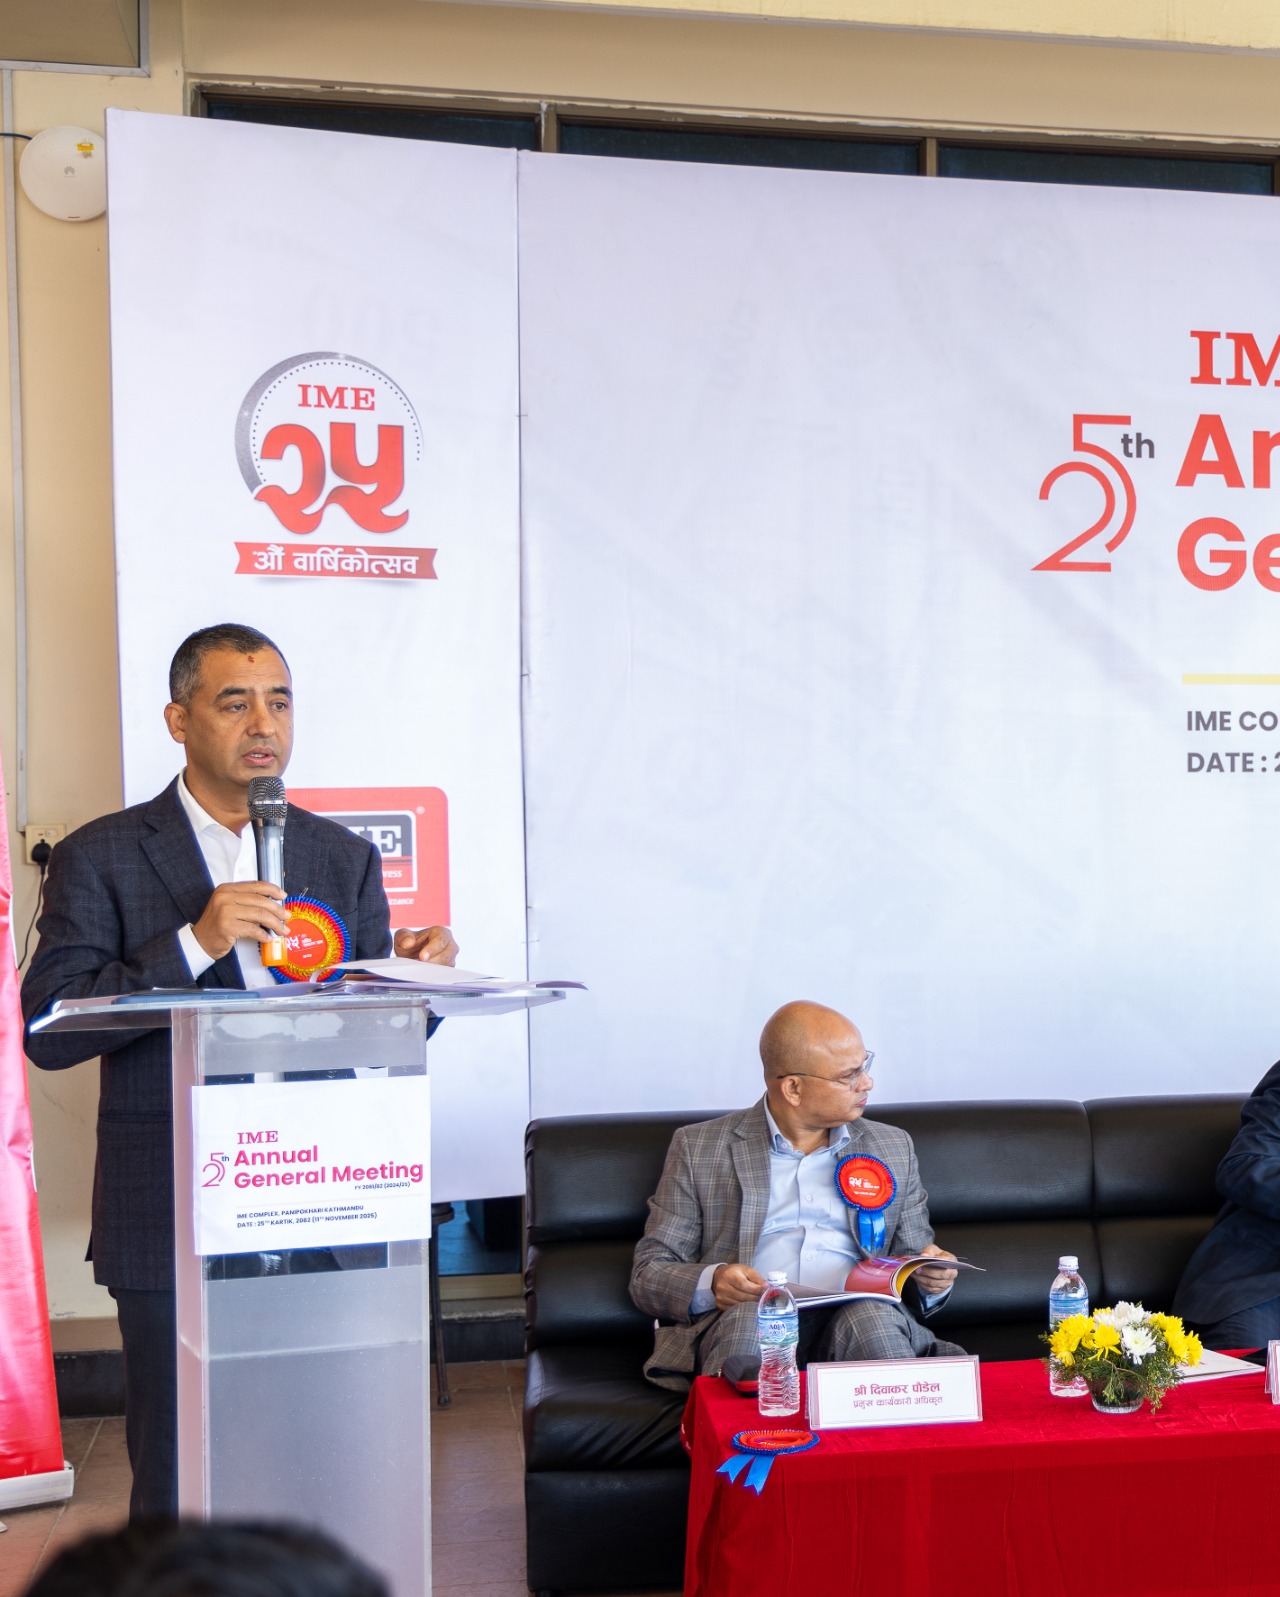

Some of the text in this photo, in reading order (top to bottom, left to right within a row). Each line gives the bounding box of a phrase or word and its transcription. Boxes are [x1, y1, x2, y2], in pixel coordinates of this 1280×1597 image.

[298, 384, 375, 411] IME
[255, 422, 409, 535] २५
[292, 547, 419, 574] वार्षिकोत्सव
[1188, 711, 1232, 732] IME
[237, 1131, 279, 1145] IME
[234, 1145, 318, 1167] Annual
[234, 1161, 424, 1189] General Meeting
[281, 1207, 324, 1216] PANIPOKHARI
[324, 1205, 364, 1213] KATHMANDU
[296, 1216, 311, 1224] 2082
[325, 1214, 359, 1222] NOVEMBER
[854, 1381, 940, 1396] श्री दिवाकर पौडेल
